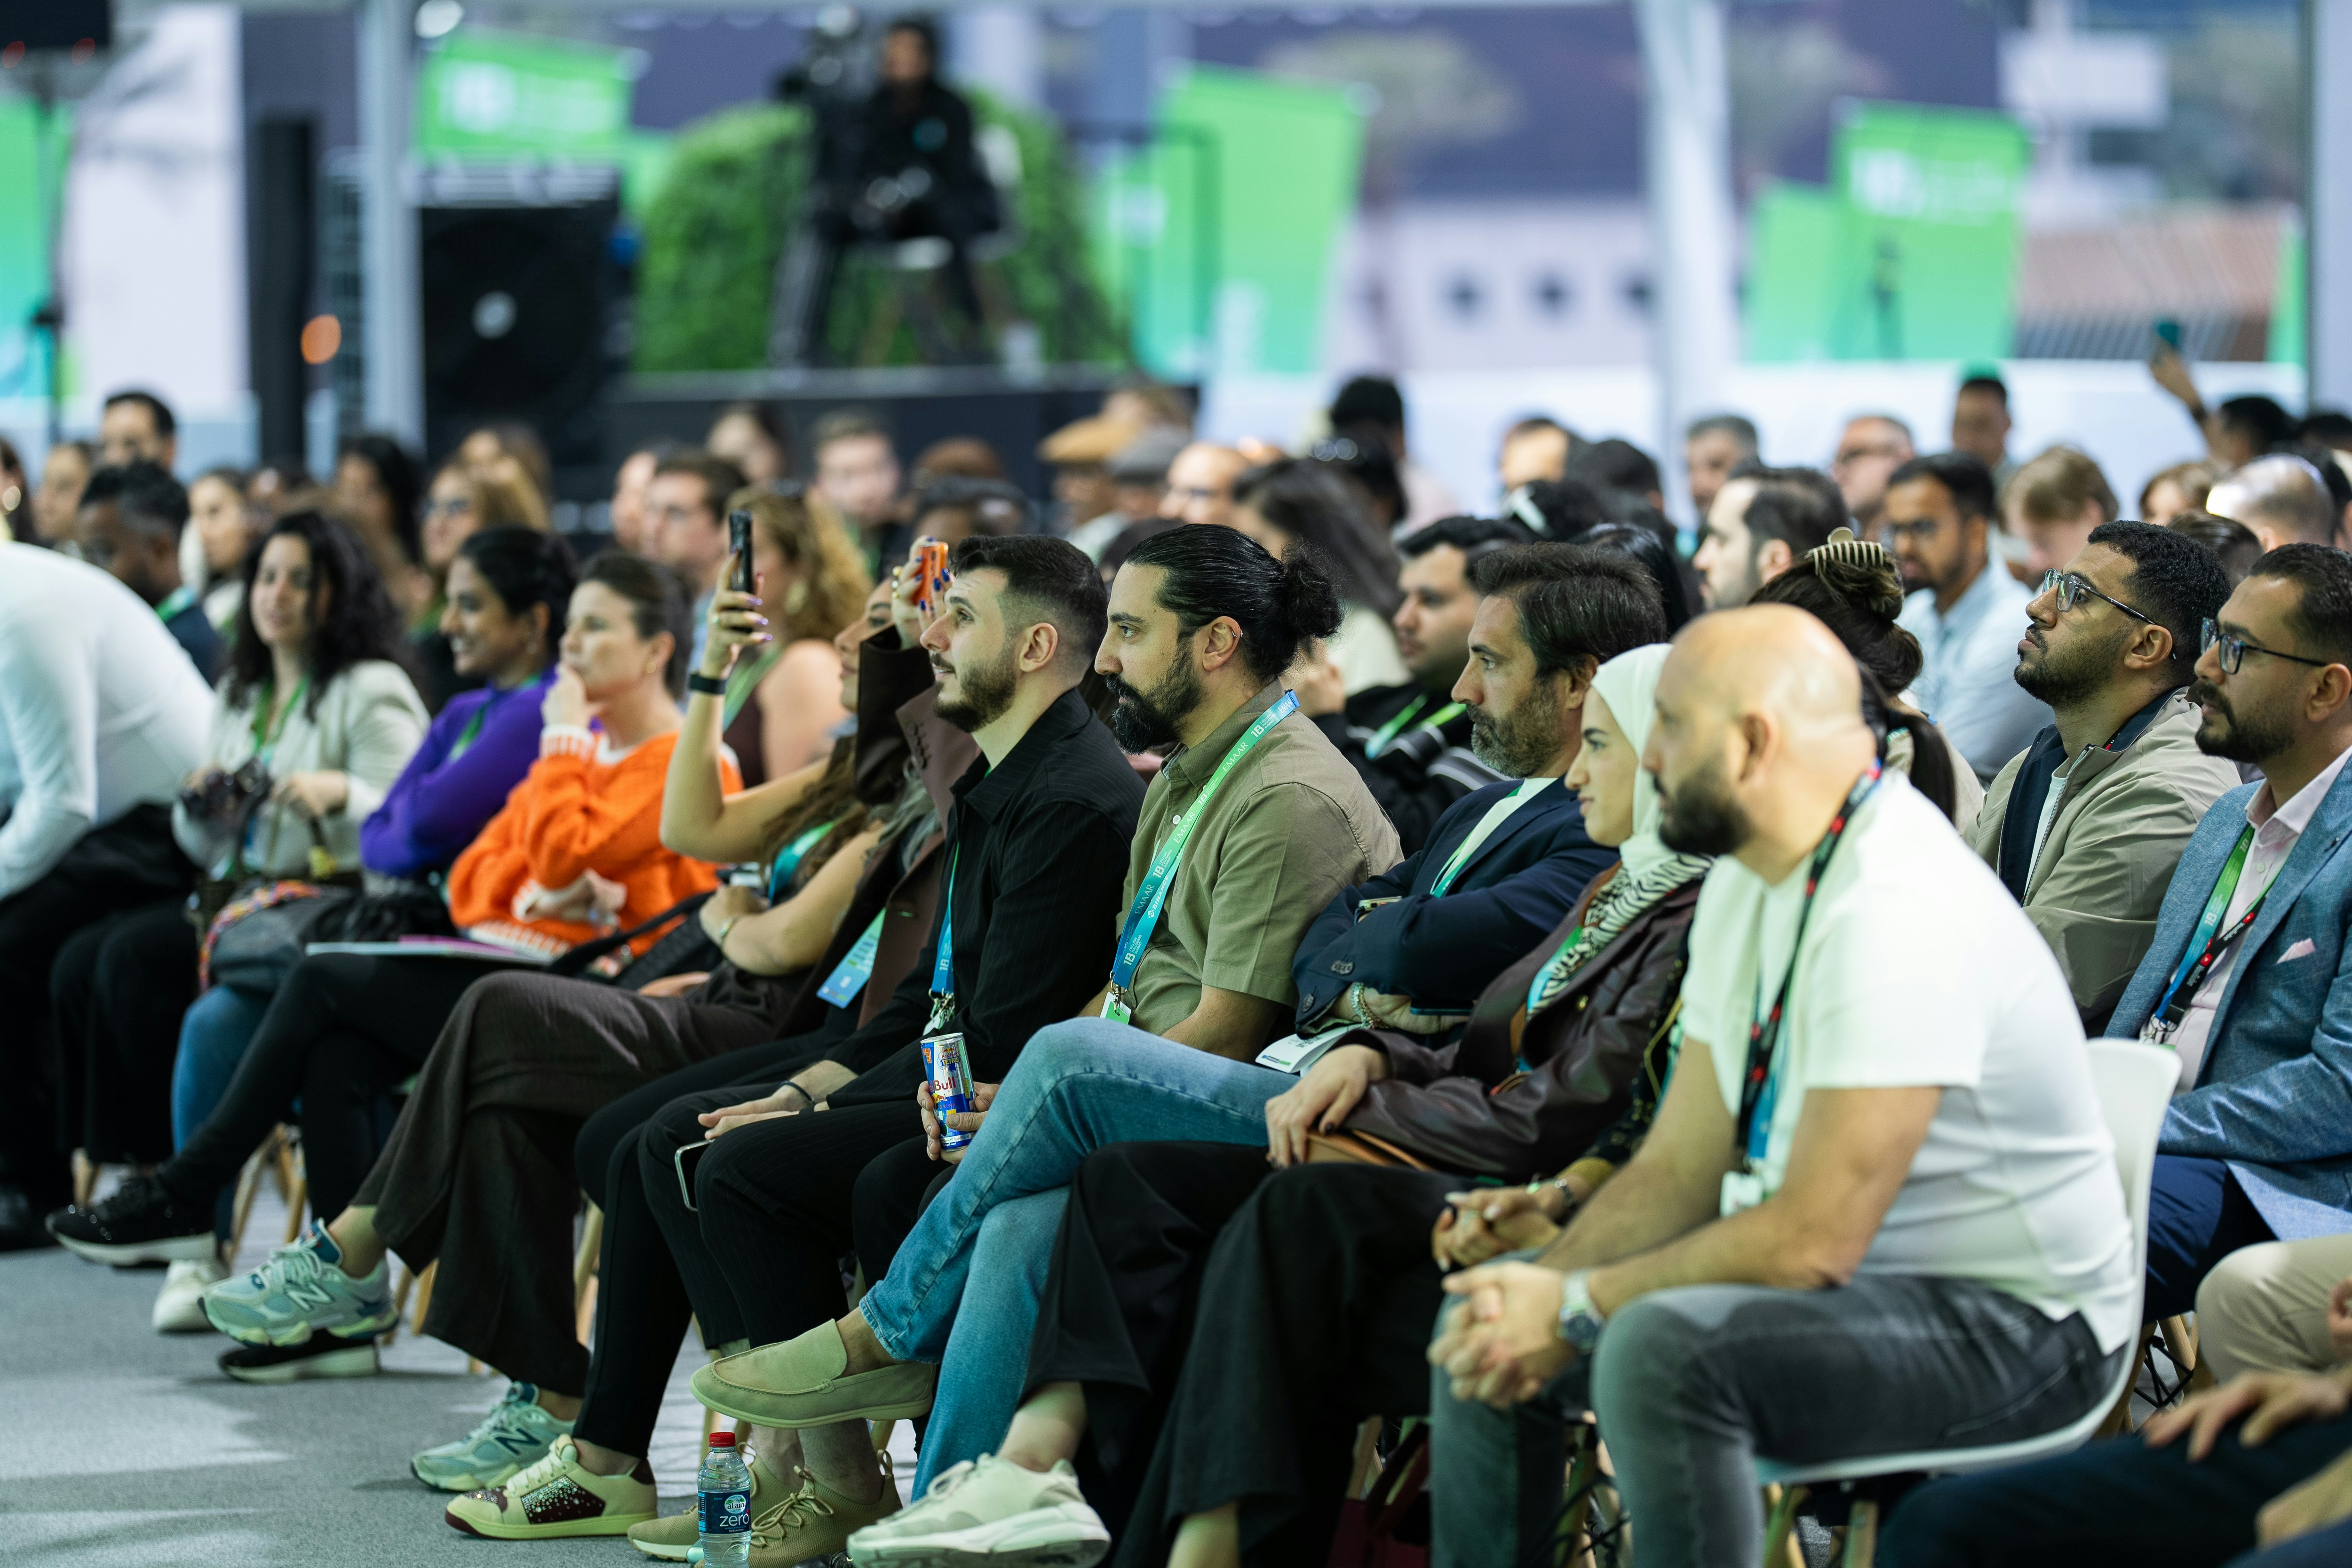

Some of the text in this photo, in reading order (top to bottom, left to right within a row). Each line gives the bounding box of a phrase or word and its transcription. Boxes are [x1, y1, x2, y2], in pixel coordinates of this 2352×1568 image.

[1251, 724, 1264, 737] 1B
[1223, 742, 1249, 772] EMAAR
[1198, 793, 1207, 805] 1B
[1174, 812, 1195, 843] EMAAR
[1152, 866, 1165, 878] 1B
[1135, 884, 1155, 914] EMAAR
[1152, 876, 1169, 910] BINANCE
[2204, 912, 2217, 926] 1B
[1131, 934, 1142, 953] FOLLOWERS
[939, 959, 950, 971] 1B
[1123, 952, 1136, 965] 1B
[942, 1057, 960, 1066] TETRIS
[720, 1513, 749, 1527] zero
